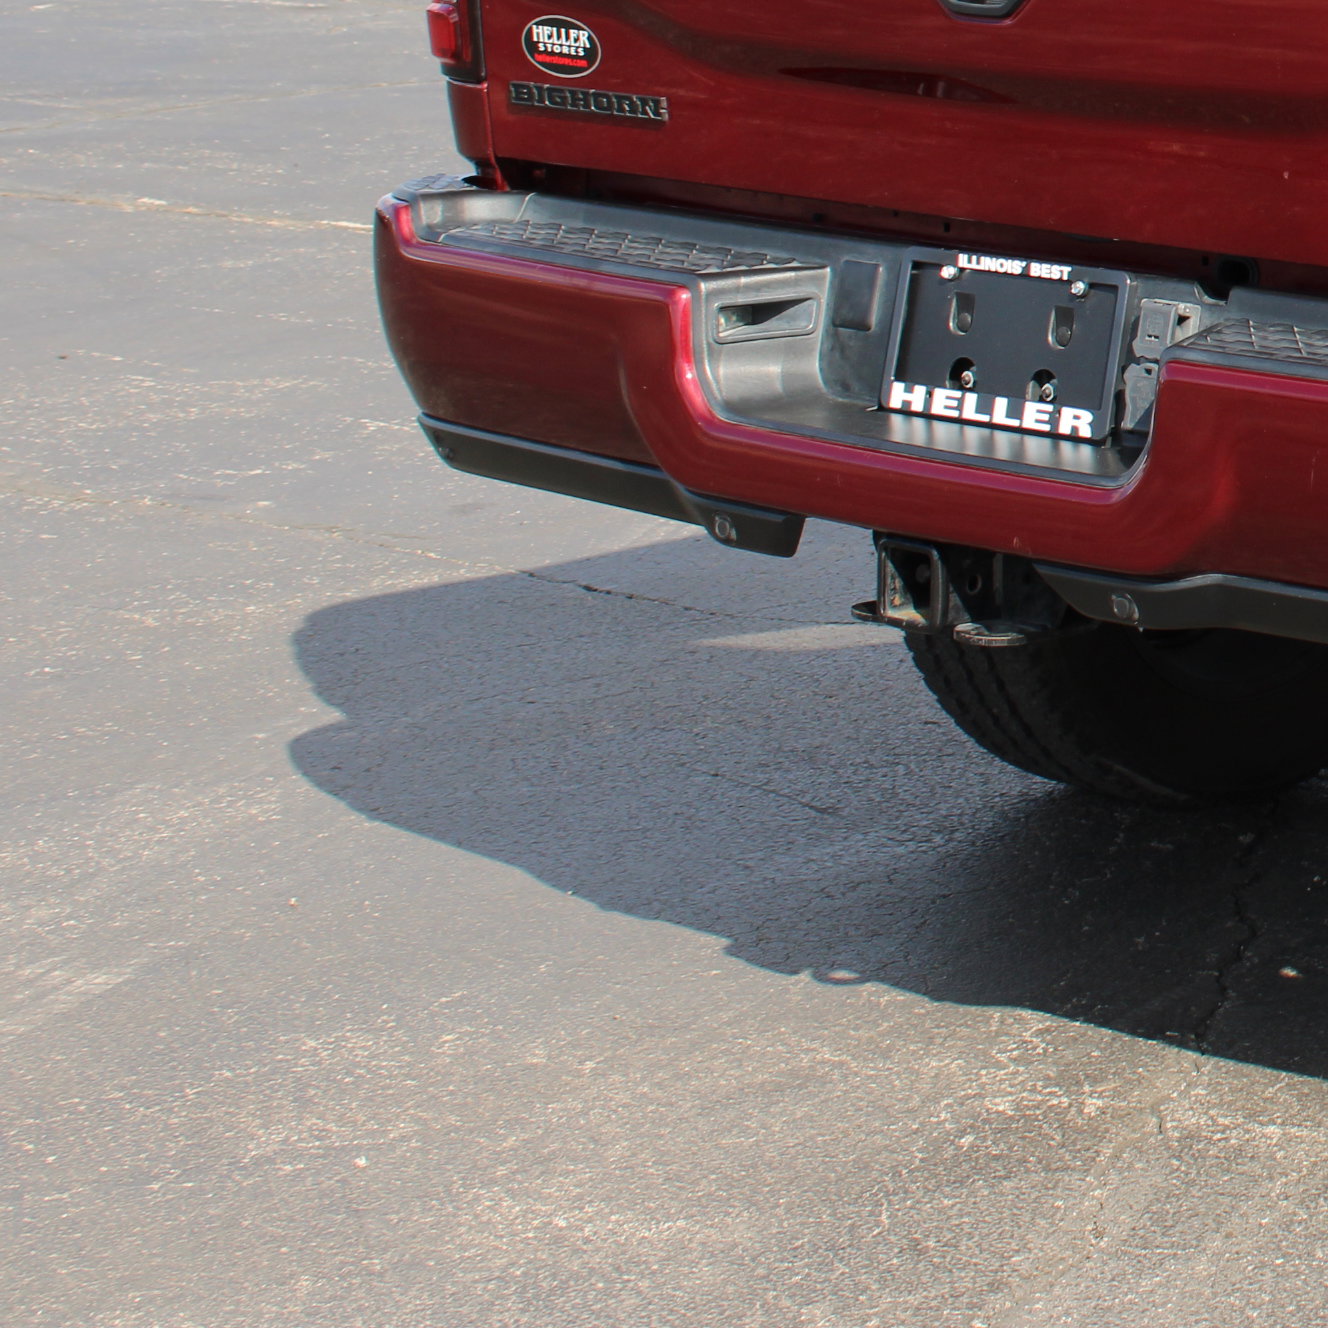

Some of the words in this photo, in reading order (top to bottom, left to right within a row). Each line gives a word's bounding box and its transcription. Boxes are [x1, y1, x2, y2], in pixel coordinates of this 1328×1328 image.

[532, 25, 590, 48] HELLER
[538, 43, 585, 56] STORES
[510, 81, 667, 121] BIGHORN
[1029, 262, 1072, 281] BEST
[888, 380, 1094, 438] HELLER
